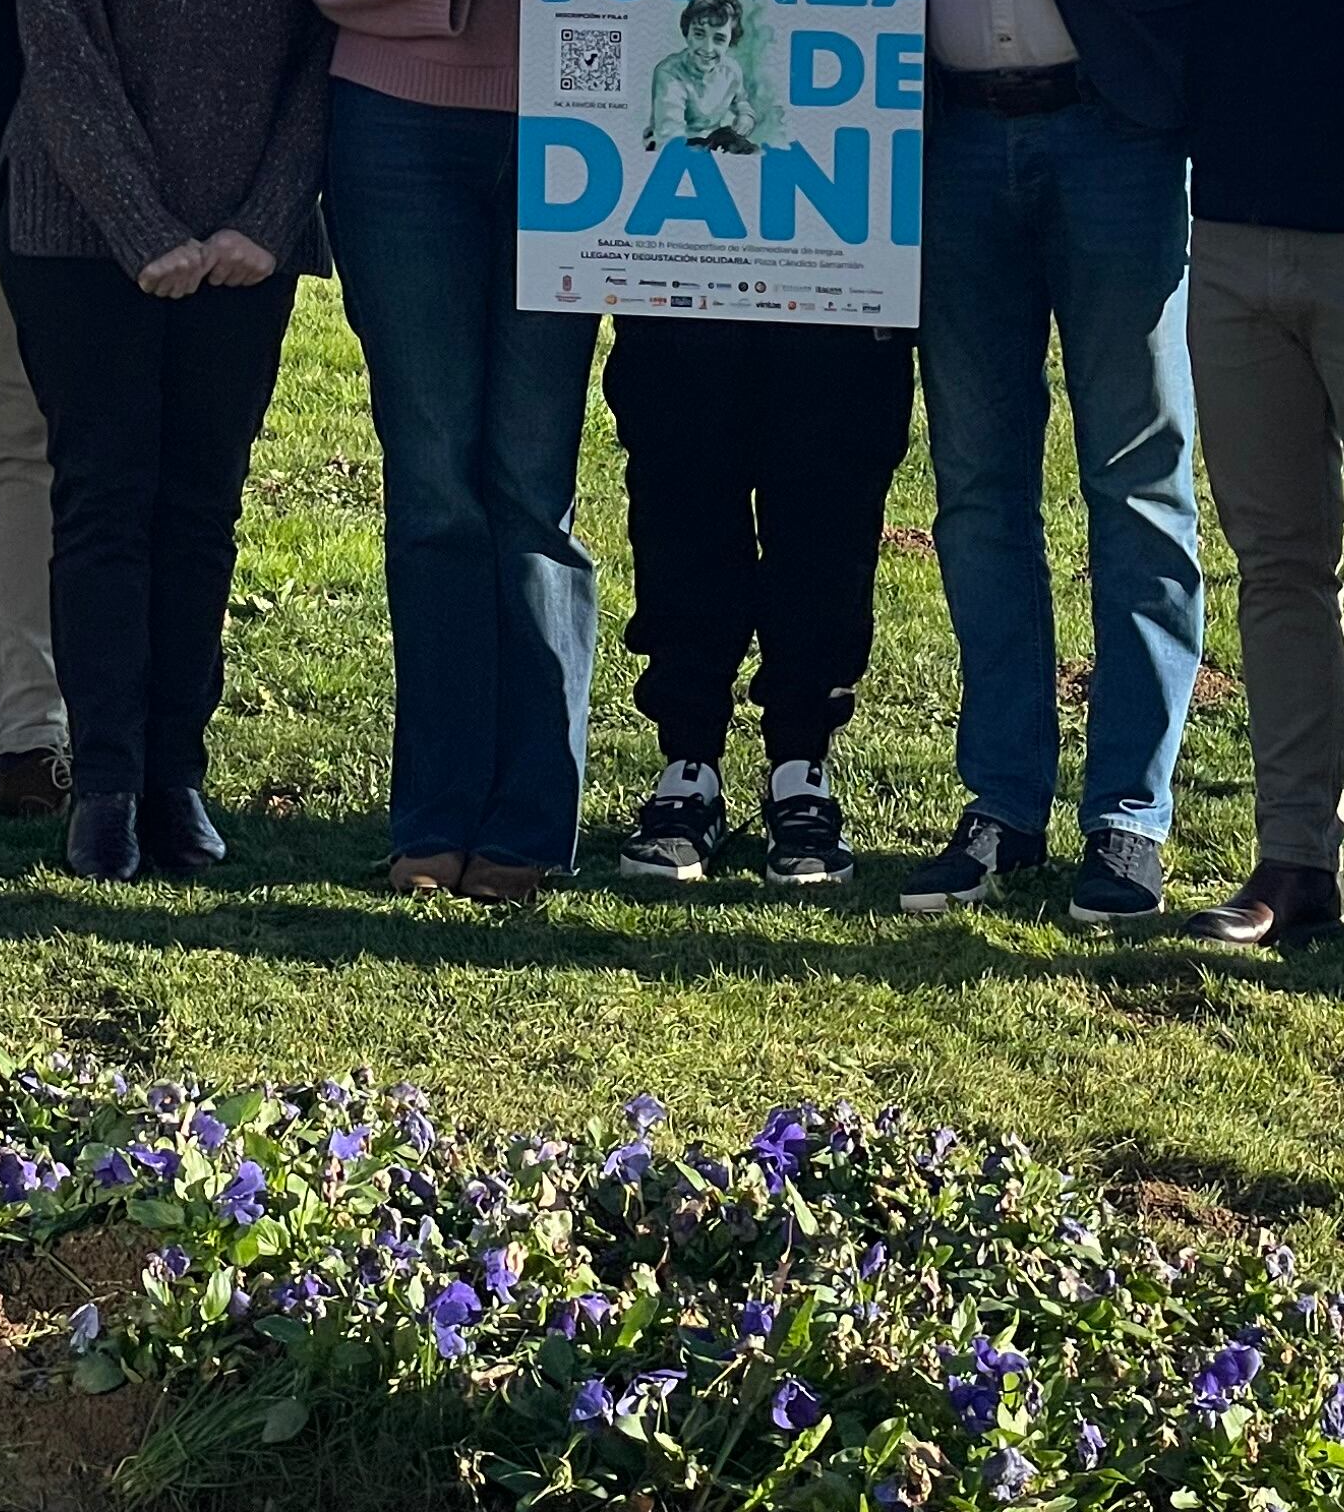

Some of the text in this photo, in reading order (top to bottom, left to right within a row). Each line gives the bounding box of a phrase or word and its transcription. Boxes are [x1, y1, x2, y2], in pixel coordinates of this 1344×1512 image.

[789, 30, 924, 110] DE
[518, 115, 921, 246] DANI
[581, 251, 622, 260] LLEGADA
[632, 252, 697, 263] DEGUSTACIÓN
[700, 255, 751, 265] SOLIDARIA:
[598, 238, 633, 248] SALIDA:
